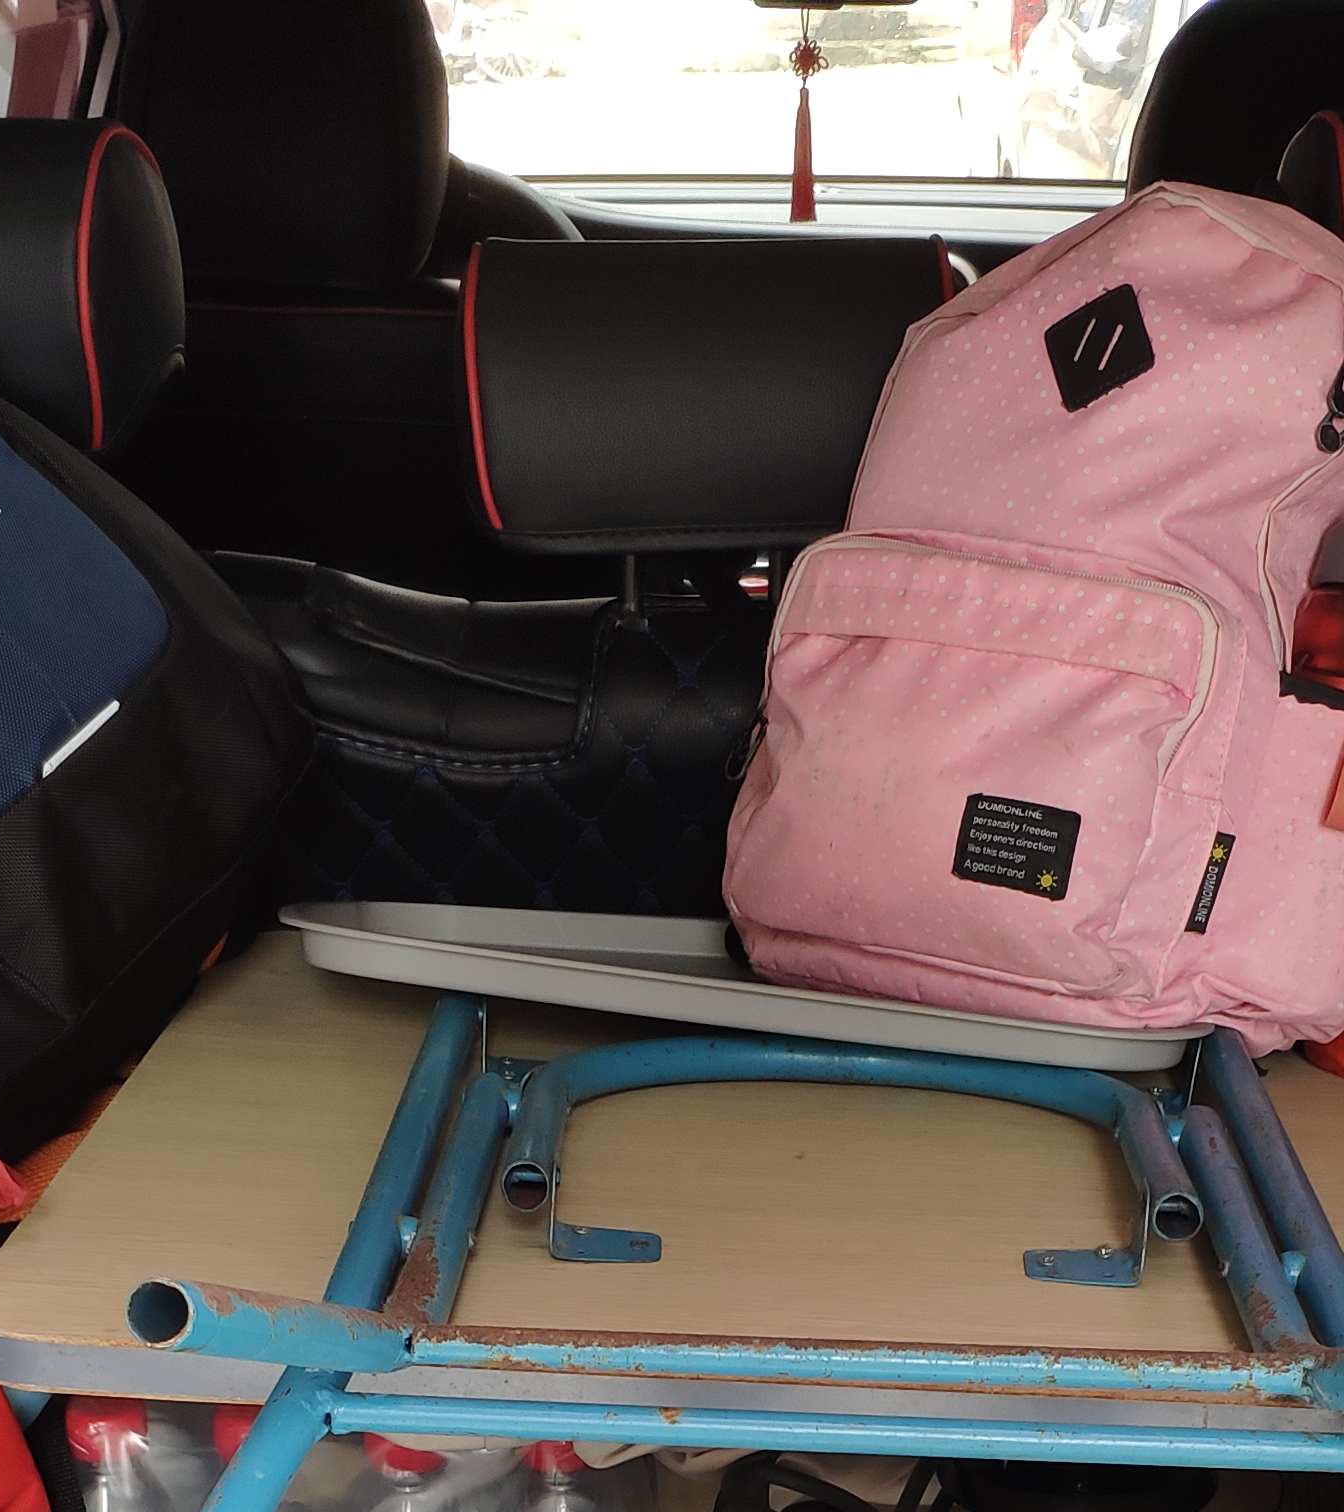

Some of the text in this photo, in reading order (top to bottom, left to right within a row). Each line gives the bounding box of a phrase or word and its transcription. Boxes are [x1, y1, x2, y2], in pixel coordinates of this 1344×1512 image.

[970, 828, 992, 842] Enjoy
[1022, 824, 1058, 839] freedom
[999, 849, 1026, 863] design
[964, 858, 1026, 879] A good brand
